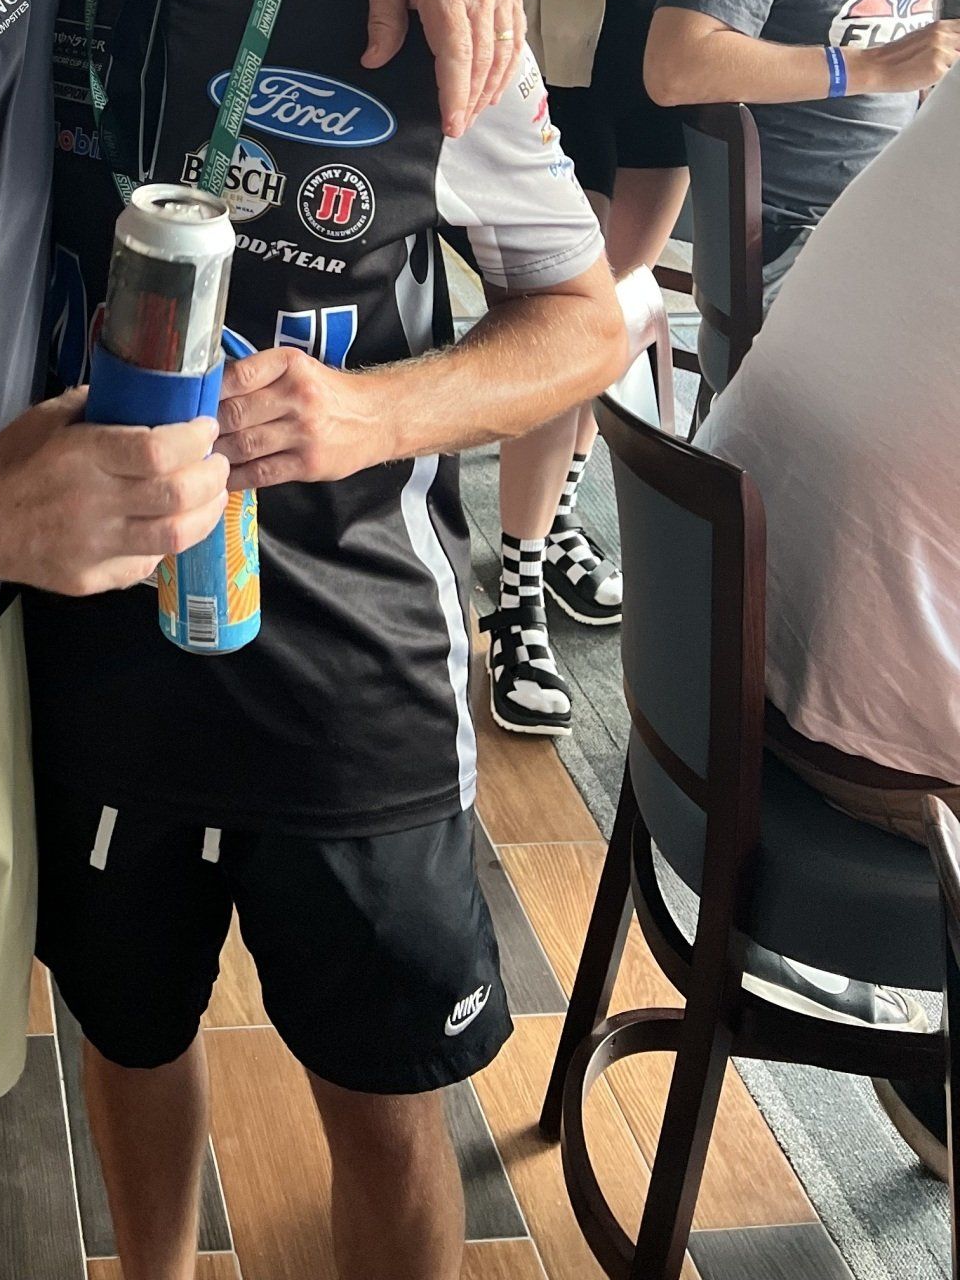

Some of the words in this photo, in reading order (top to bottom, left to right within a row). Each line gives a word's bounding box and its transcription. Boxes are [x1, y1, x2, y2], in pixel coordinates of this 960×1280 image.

[224, 66, 243, 108] RACING
[246, 76, 362, 136] Ford
[182, 155, 284, 203] BSCH
[303, 169, 342, 199] JIMMY
[343, 171, 370, 211] JOHN'S
[302, 201, 326, 233] GOURMET
[326, 214, 367, 237] SANDWICHES
[316, 183, 357, 224] JJ
[234, 233, 347, 274] ODYEAR
[452, 985, 484, 1022] NIKE
